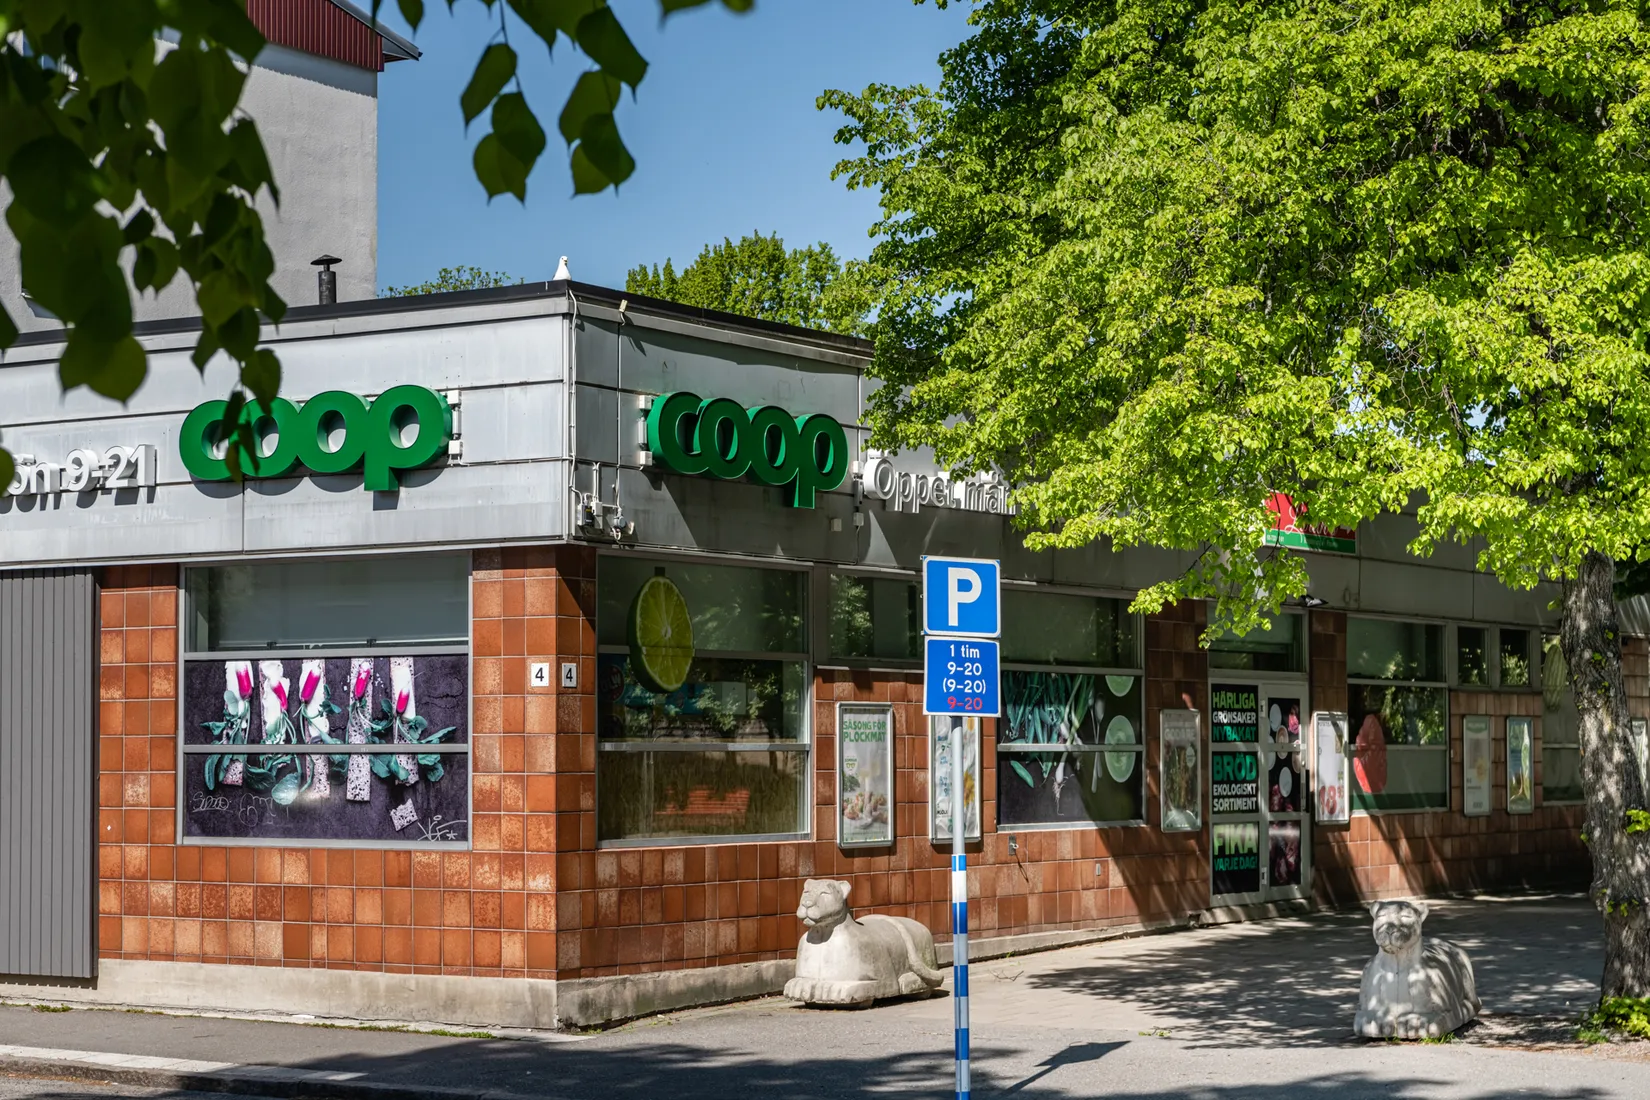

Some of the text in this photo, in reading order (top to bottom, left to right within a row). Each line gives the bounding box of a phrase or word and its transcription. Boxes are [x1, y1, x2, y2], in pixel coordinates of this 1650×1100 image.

[179, 385, 453, 491] coop
[647, 391, 849, 510] coop
[3, 444, 155, 497] ön 9-21
[863, 449, 956, 513] Öppet
[948, 567, 982, 627] P
[950, 644, 980, 659] 1 tim
[535, 667, 544, 682] 4
[565, 667, 573, 682] 4
[947, 662, 982, 676] 9-20
[943, 678, 986, 694] (9-20)
[947, 696, 983, 711] 9-20
[1212, 690, 1256, 709] HÄRLIGA
[1212, 710, 1257, 724] GRÖNSAKER
[843, 731, 886, 743] PLOCKMAT
[1213, 725, 1257, 741] NYBAKAT
[1213, 753, 1257, 781] BRÖD
[1213, 783, 1257, 796] EKOLOGISKT
[1213, 797, 1257, 811] SORTIMENT
[1213, 823, 1259, 855] FIKA
[1214, 858, 1239, 871] VARJE
